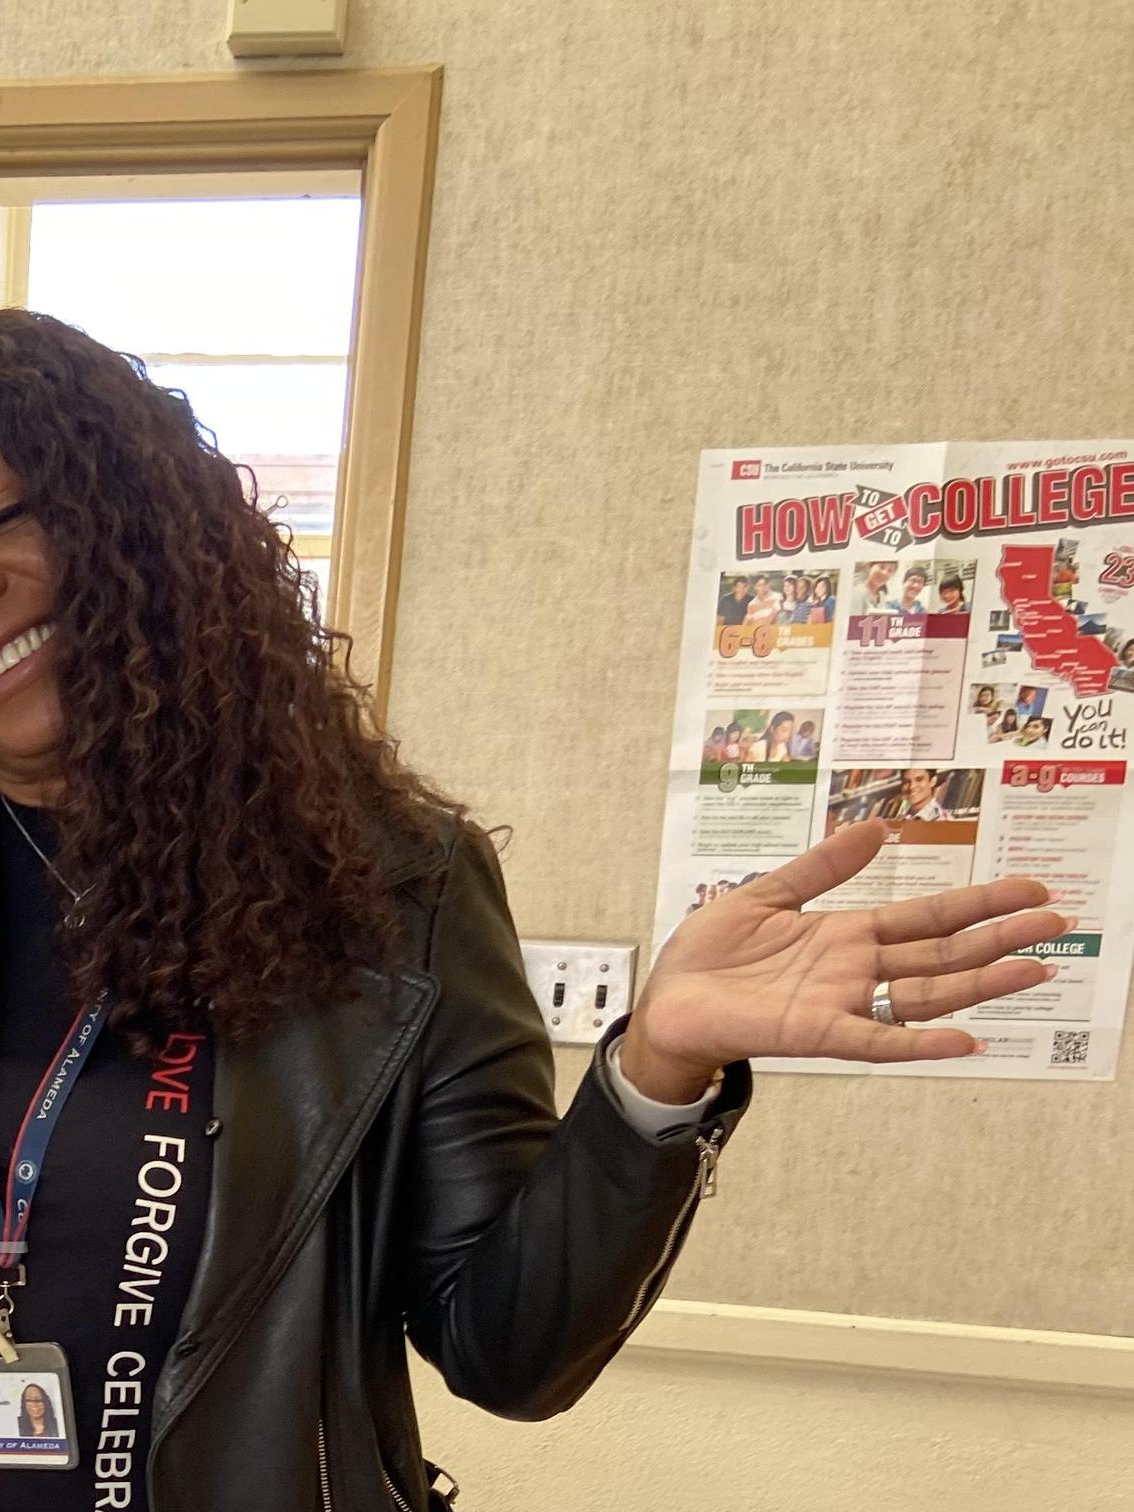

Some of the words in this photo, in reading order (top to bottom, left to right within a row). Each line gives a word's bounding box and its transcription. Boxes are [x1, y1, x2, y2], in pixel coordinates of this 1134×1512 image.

[739, 463, 760, 477] CSU
[765, 463, 780, 473] The
[782, 462, 823, 473] California
[825, 462, 847, 472] State
[850, 461, 894, 472] University
[1007, 450, 1127, 471] www.gotocsu.com
[861, 488, 880, 507] TO
[906, 463, 1134, 540] COLLEGE
[738, 493, 856, 558] HOW
[864, 503, 895, 532] GET
[883, 528, 902, 546] TO
[719, 624, 772, 658] 6-8
[858, 615, 888, 648] 11
[888, 627, 921, 638] GRADE
[1078, 720, 1107, 734] can
[1061, 729, 1093, 749] do
[1099, 728, 1127, 750] it!
[718, 762, 739, 793] 9
[740, 773, 772, 784] GRADE
[1060, 772, 1106, 784] COURSES
[1036, 942, 1086, 955] COLLEGE
[77, 1024, 93, 1047] OF
[37, 1047, 80, 1120] ALAMEDA
[113, 1133, 186, 1327] FORGIVE
[6, 1441, 17, 1449] OF
[19, 1440, 60, 1450] ALAMEDA
